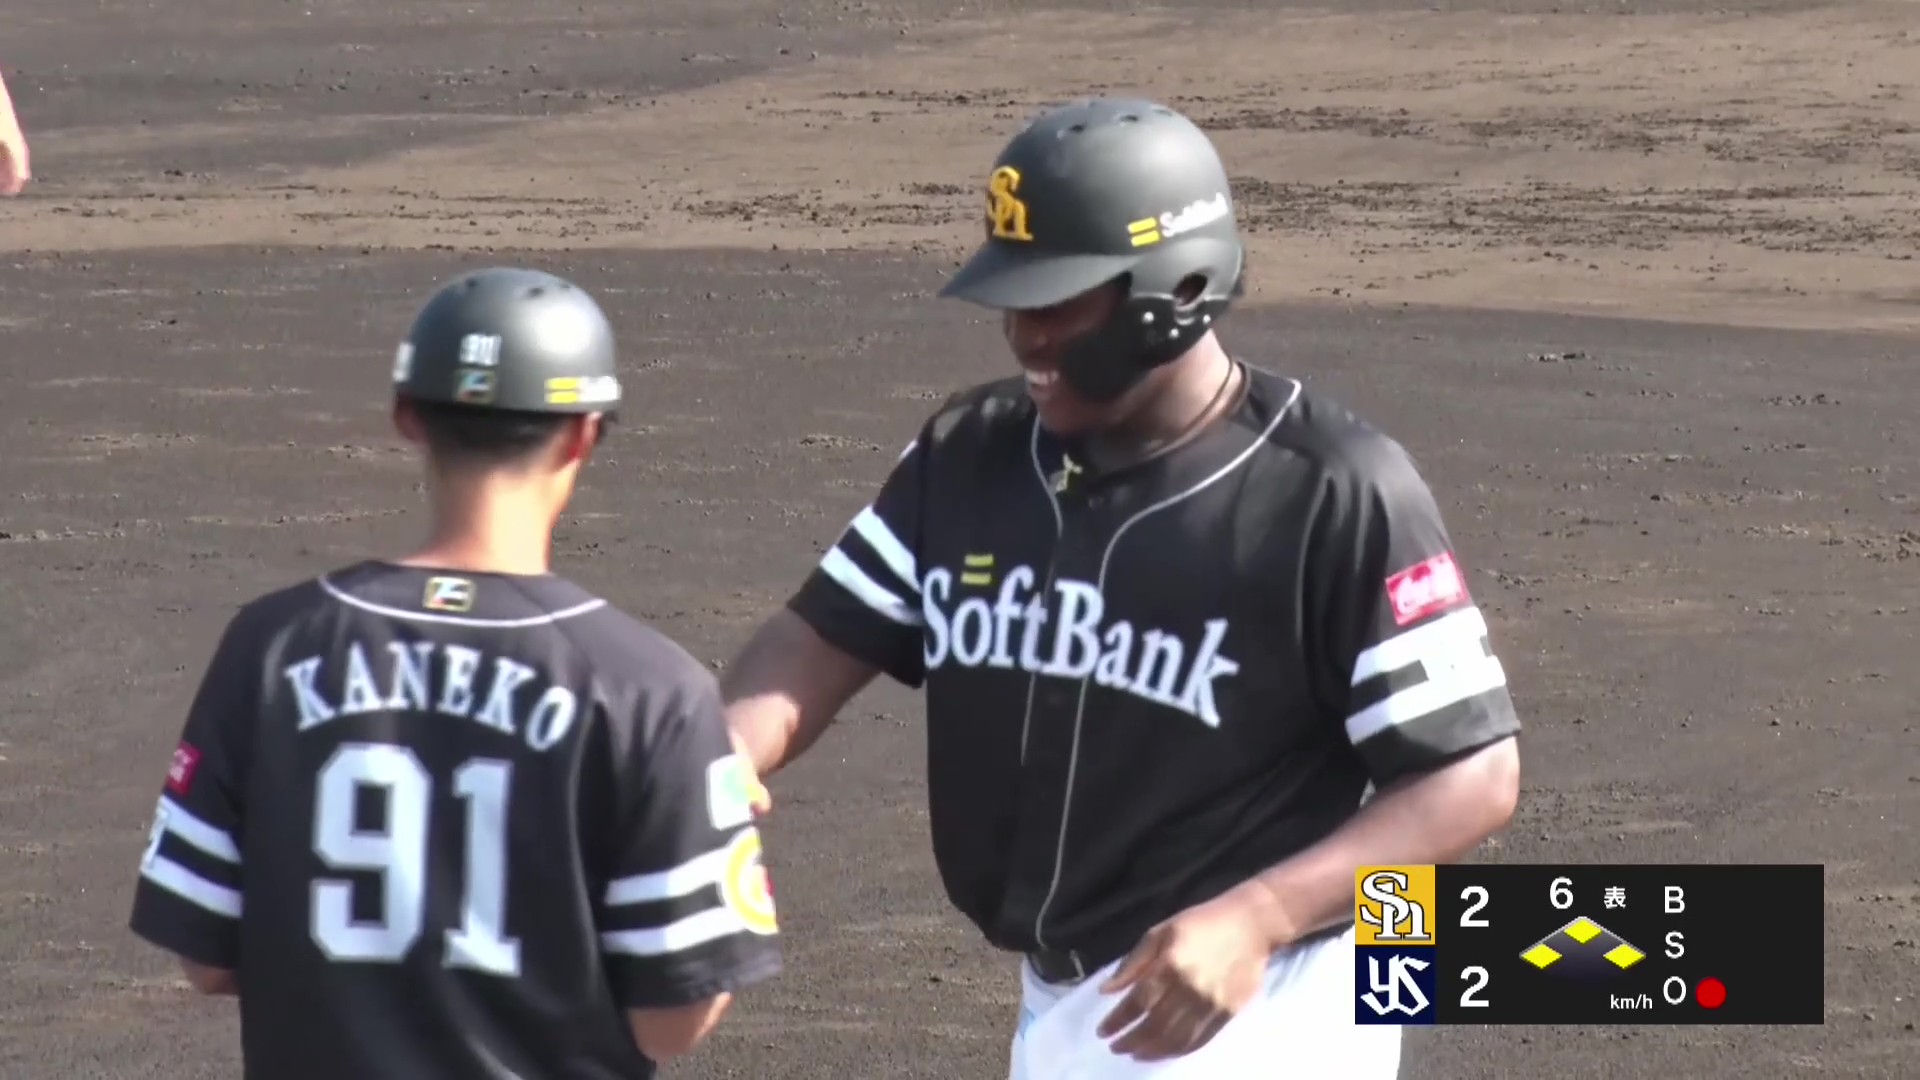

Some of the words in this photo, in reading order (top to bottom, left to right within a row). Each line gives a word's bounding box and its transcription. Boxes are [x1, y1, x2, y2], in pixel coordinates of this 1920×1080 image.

[284, 640, 577, 752] KANEKO
[923, 564, 1240, 728] SoftBank
[309, 742, 522, 978] 91
